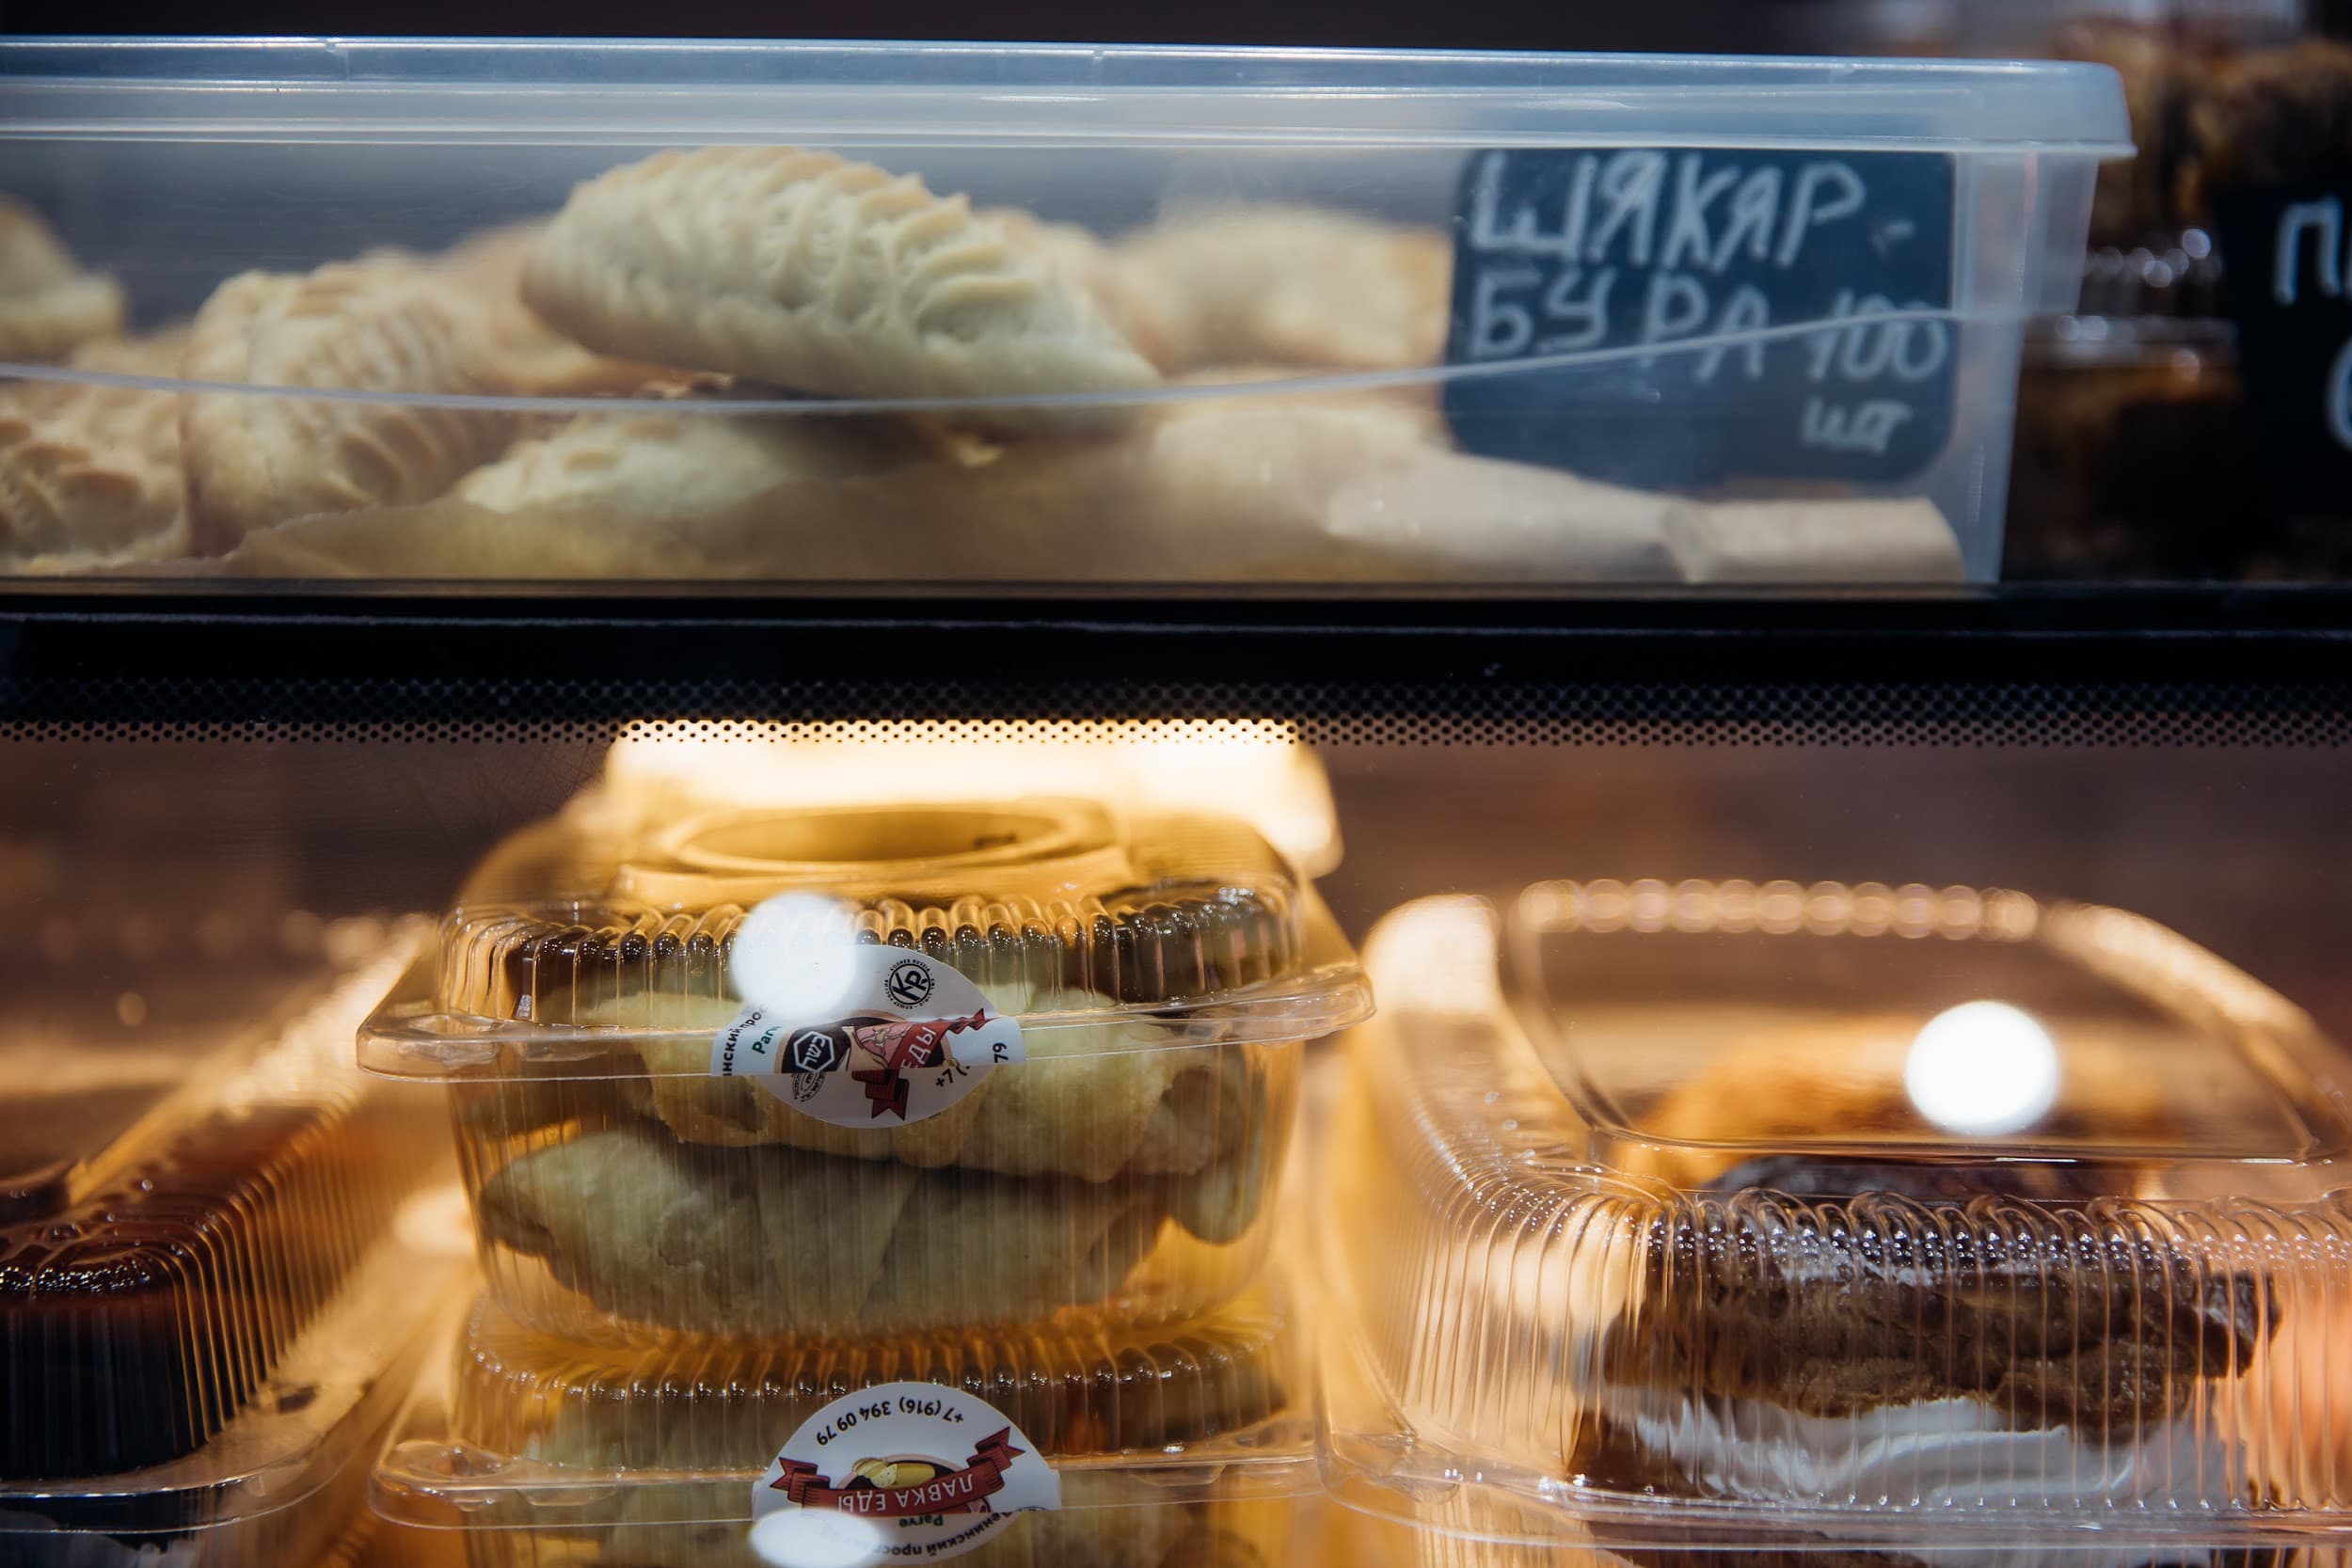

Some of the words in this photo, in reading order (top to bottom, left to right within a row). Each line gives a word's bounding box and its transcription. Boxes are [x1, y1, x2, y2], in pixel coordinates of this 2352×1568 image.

[1806, 290, 1947, 382] 100
[859, 1400, 892, 1422] 394
[898, 1396, 942, 1417] (916)
[943, 1406, 964, 1423] +7
[836, 1411, 858, 1433] 09
[816, 1424, 837, 1447] 79
[836, 1489, 887, 1513] ЕДЫ
[895, 1472, 975, 1508] ЛАВКА
[898, 1513, 945, 1528] Parve
